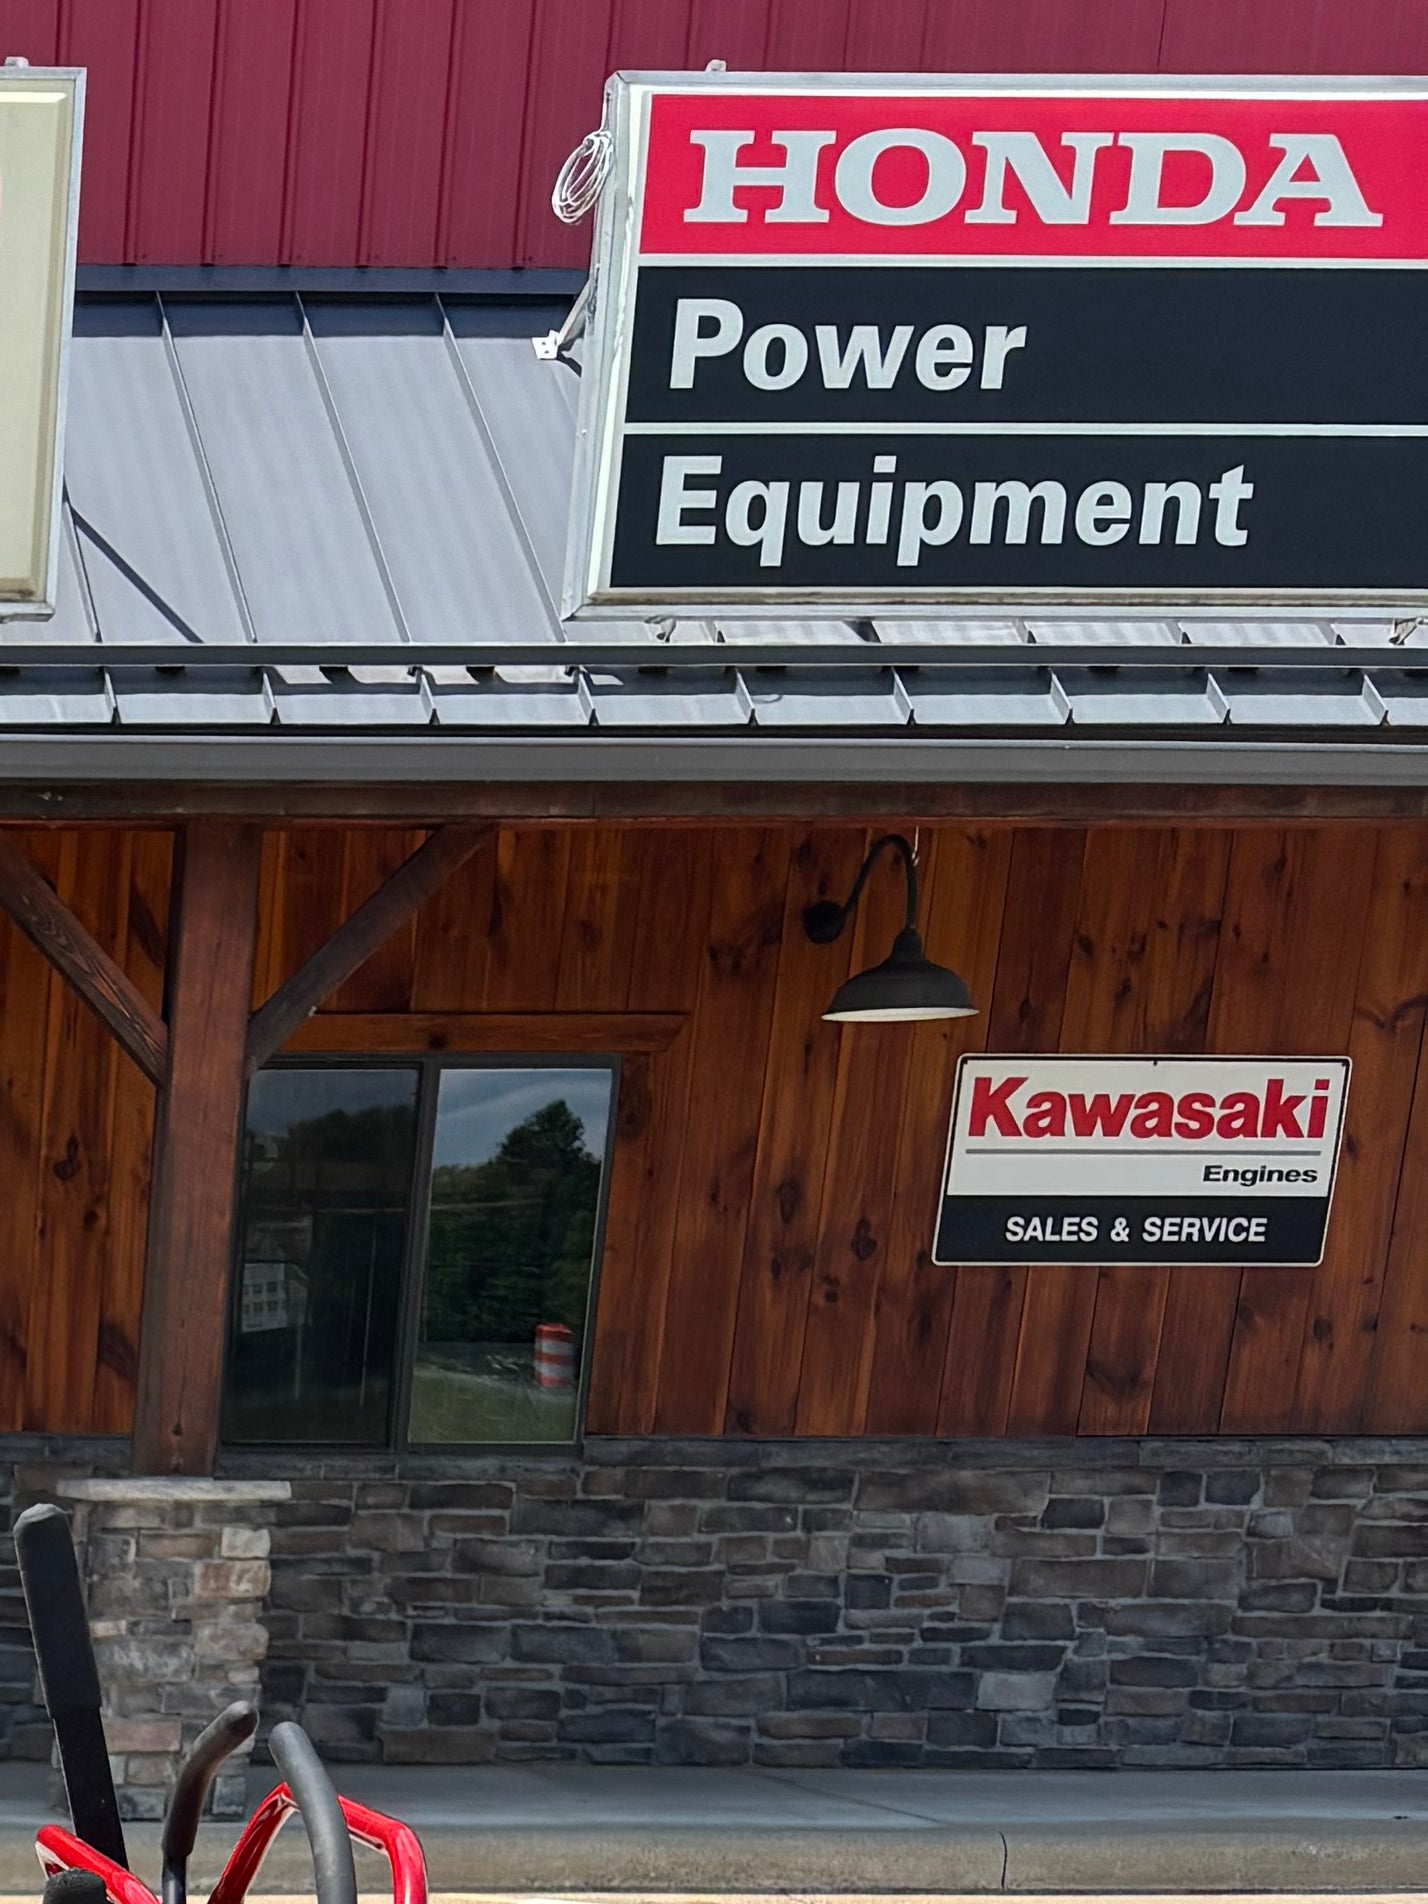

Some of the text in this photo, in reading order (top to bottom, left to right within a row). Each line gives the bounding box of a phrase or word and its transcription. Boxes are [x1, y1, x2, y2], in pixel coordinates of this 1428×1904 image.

[682, 126, 1384, 228] HONDA
[668, 297, 1028, 392] Power
[654, 453, 1255, 568] Equipment
[967, 1075, 1331, 1141] Kawasaki
[1202, 1164, 1319, 1188] Engines
[1004, 1215, 1269, 1244] SALES & SERVICE
